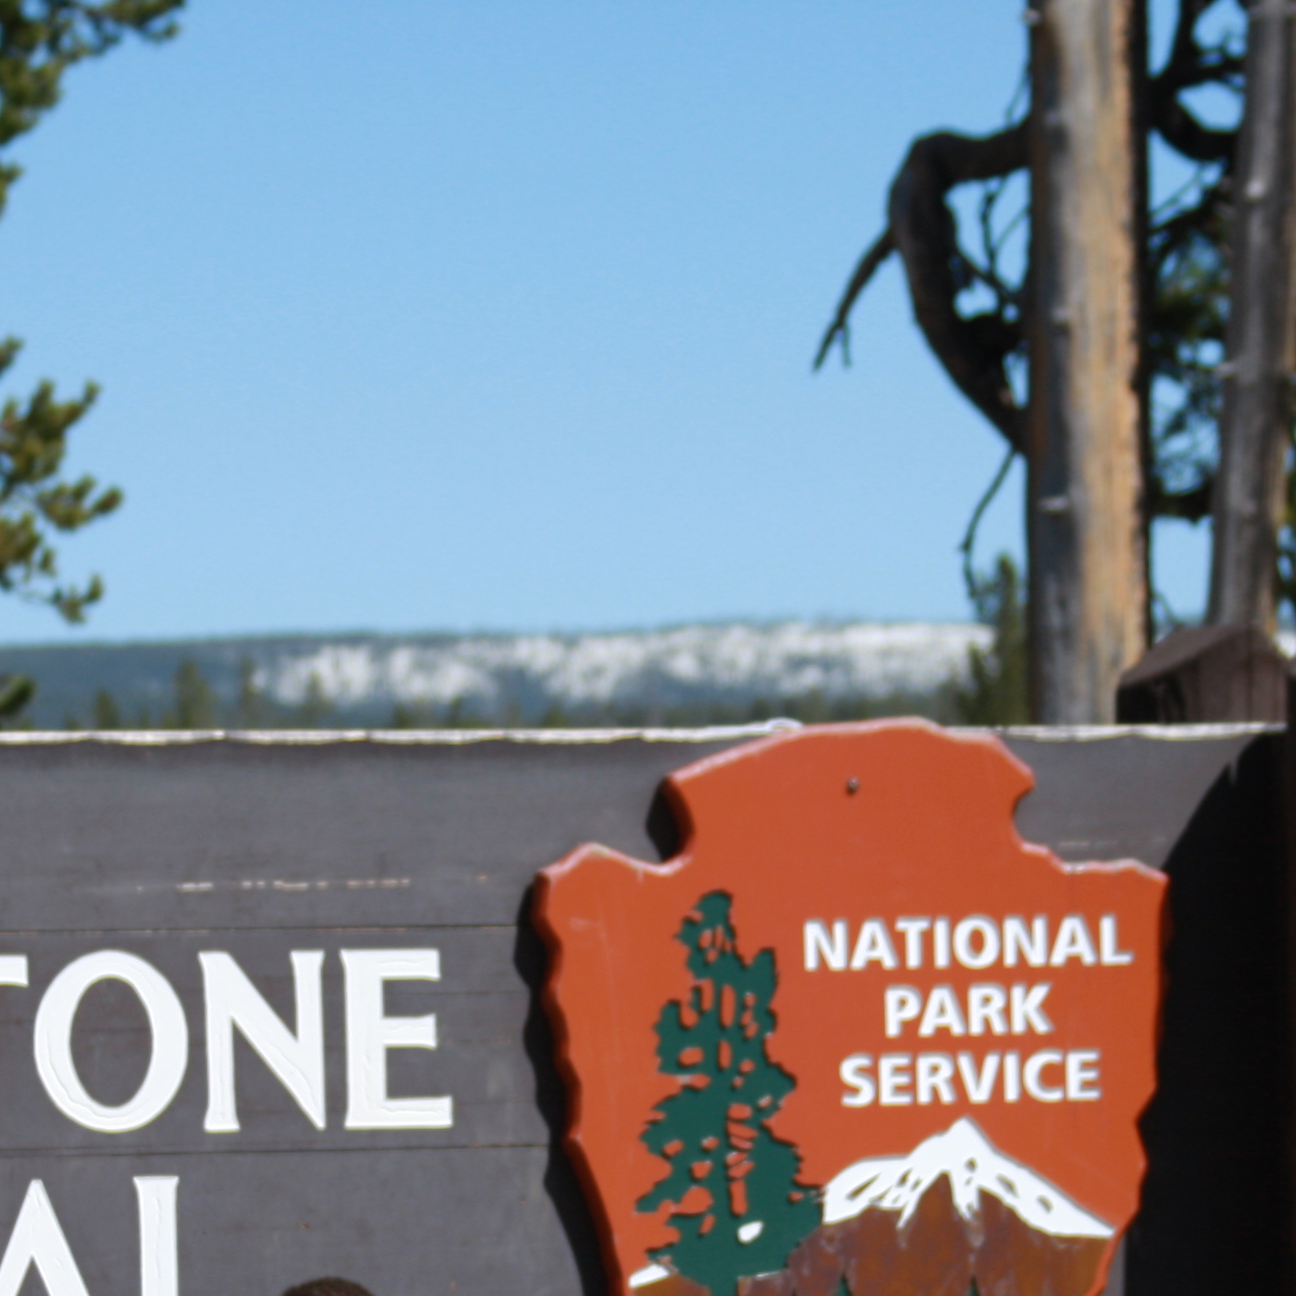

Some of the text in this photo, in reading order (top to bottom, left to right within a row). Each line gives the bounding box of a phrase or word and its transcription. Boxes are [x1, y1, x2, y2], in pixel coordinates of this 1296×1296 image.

[804, 915, 1133, 971] NATIONAL
[884, 982, 1052, 1037] PARK
[839, 1049, 1101, 1107] SERVICE
